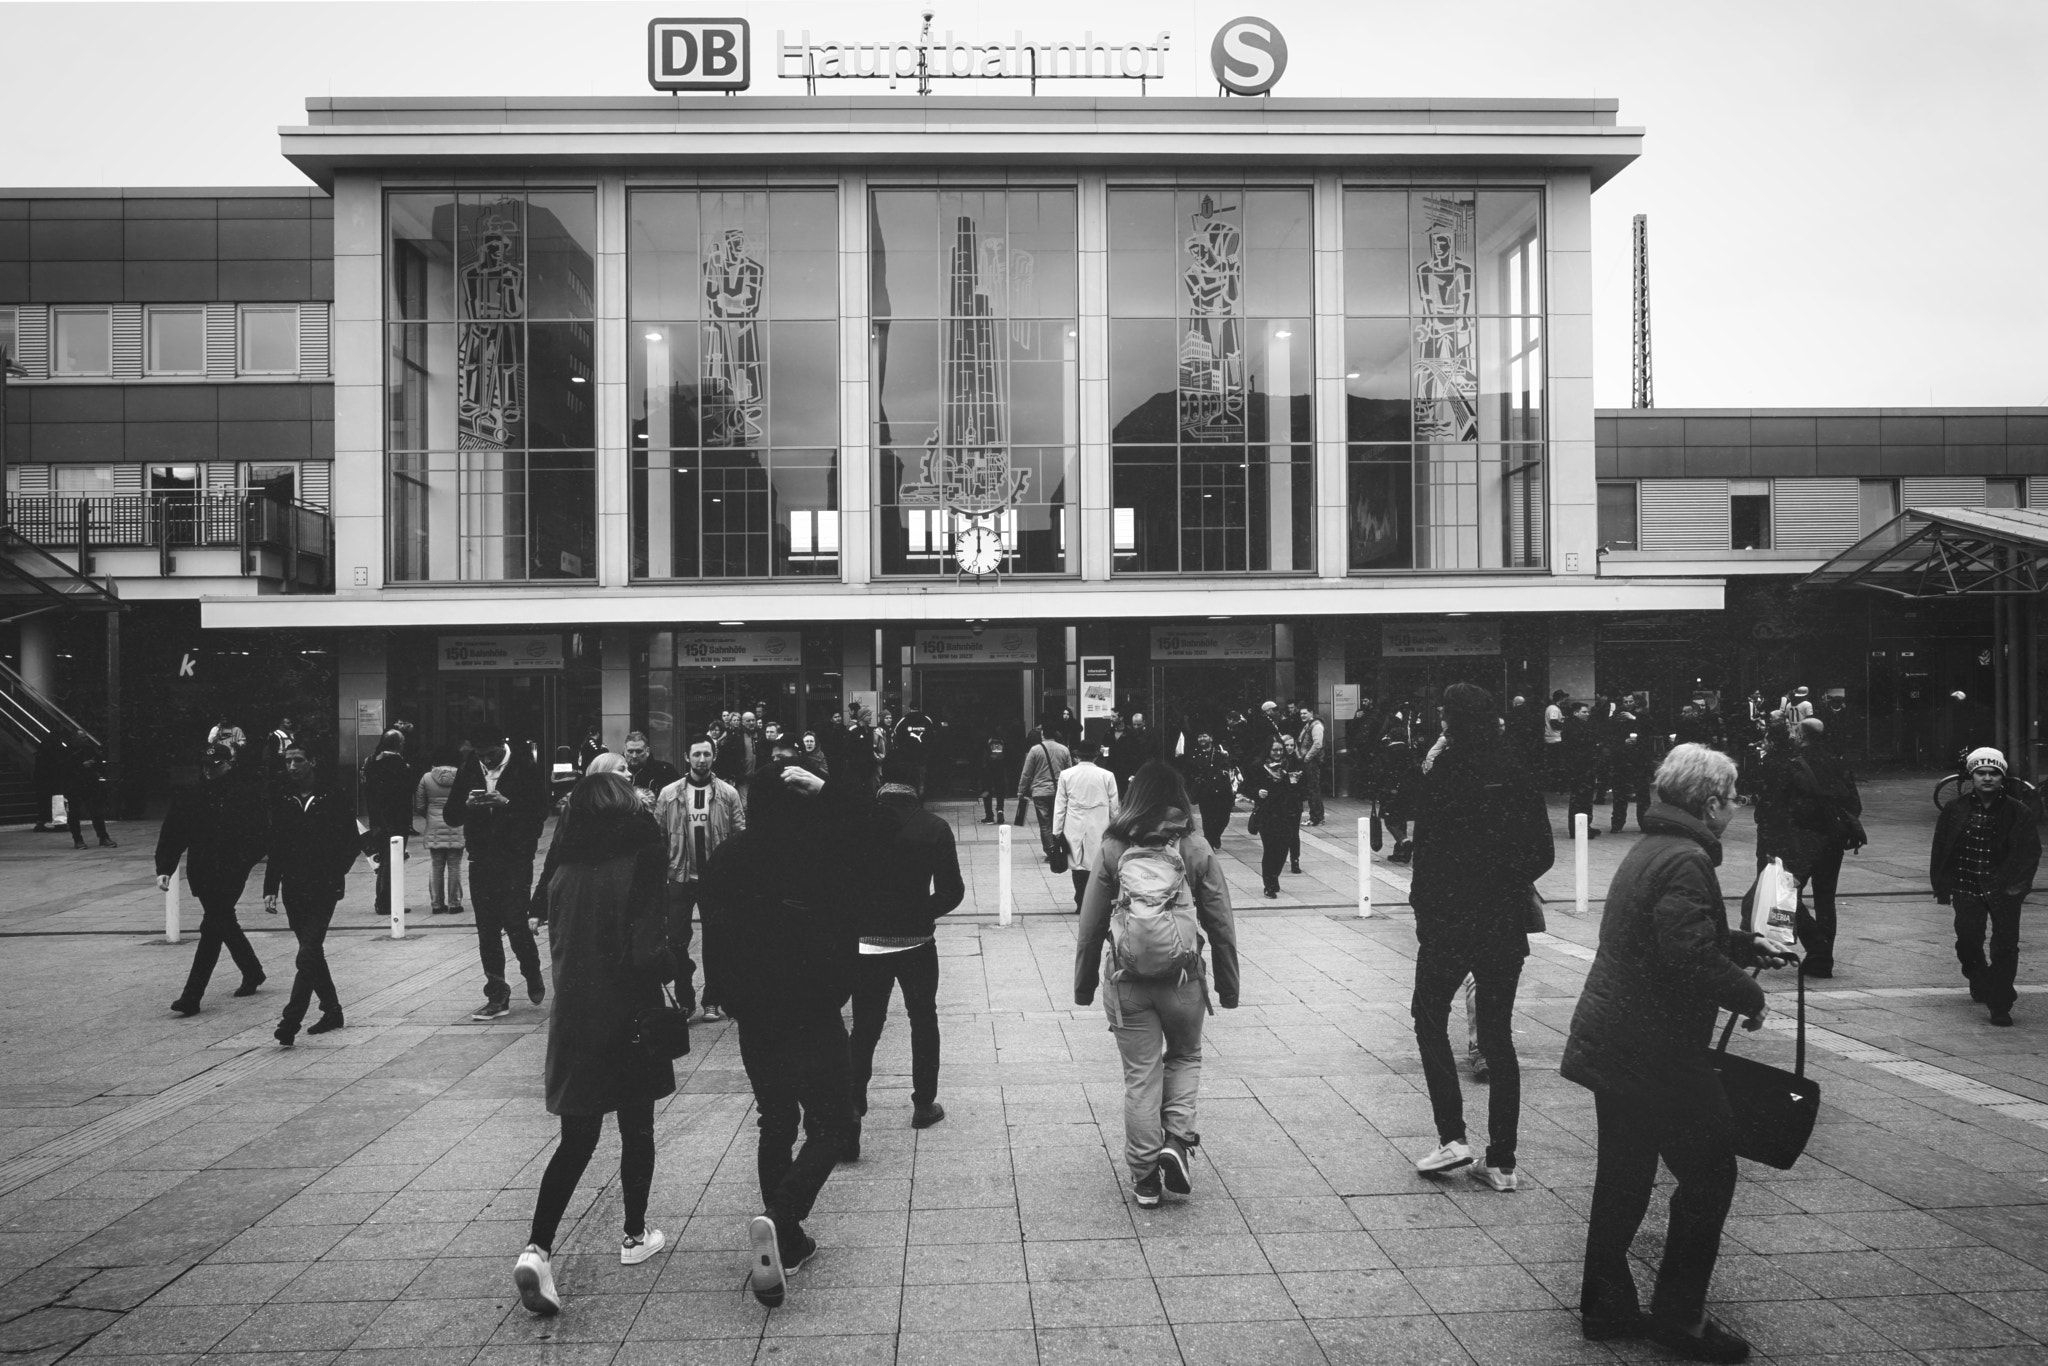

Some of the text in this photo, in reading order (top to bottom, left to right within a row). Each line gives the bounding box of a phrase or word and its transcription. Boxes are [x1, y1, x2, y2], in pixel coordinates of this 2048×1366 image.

[661, 29, 738, 76] DB
[777, 29, 1170, 89] Hauptbahnhof
[1223, 23, 1275, 87] S
[684, 644, 708, 656] 150
[922, 641, 945, 653] 150
[1157, 636, 1180, 649] 150
[445, 646, 468, 660] 150
[179, 653, 196, 677] k
